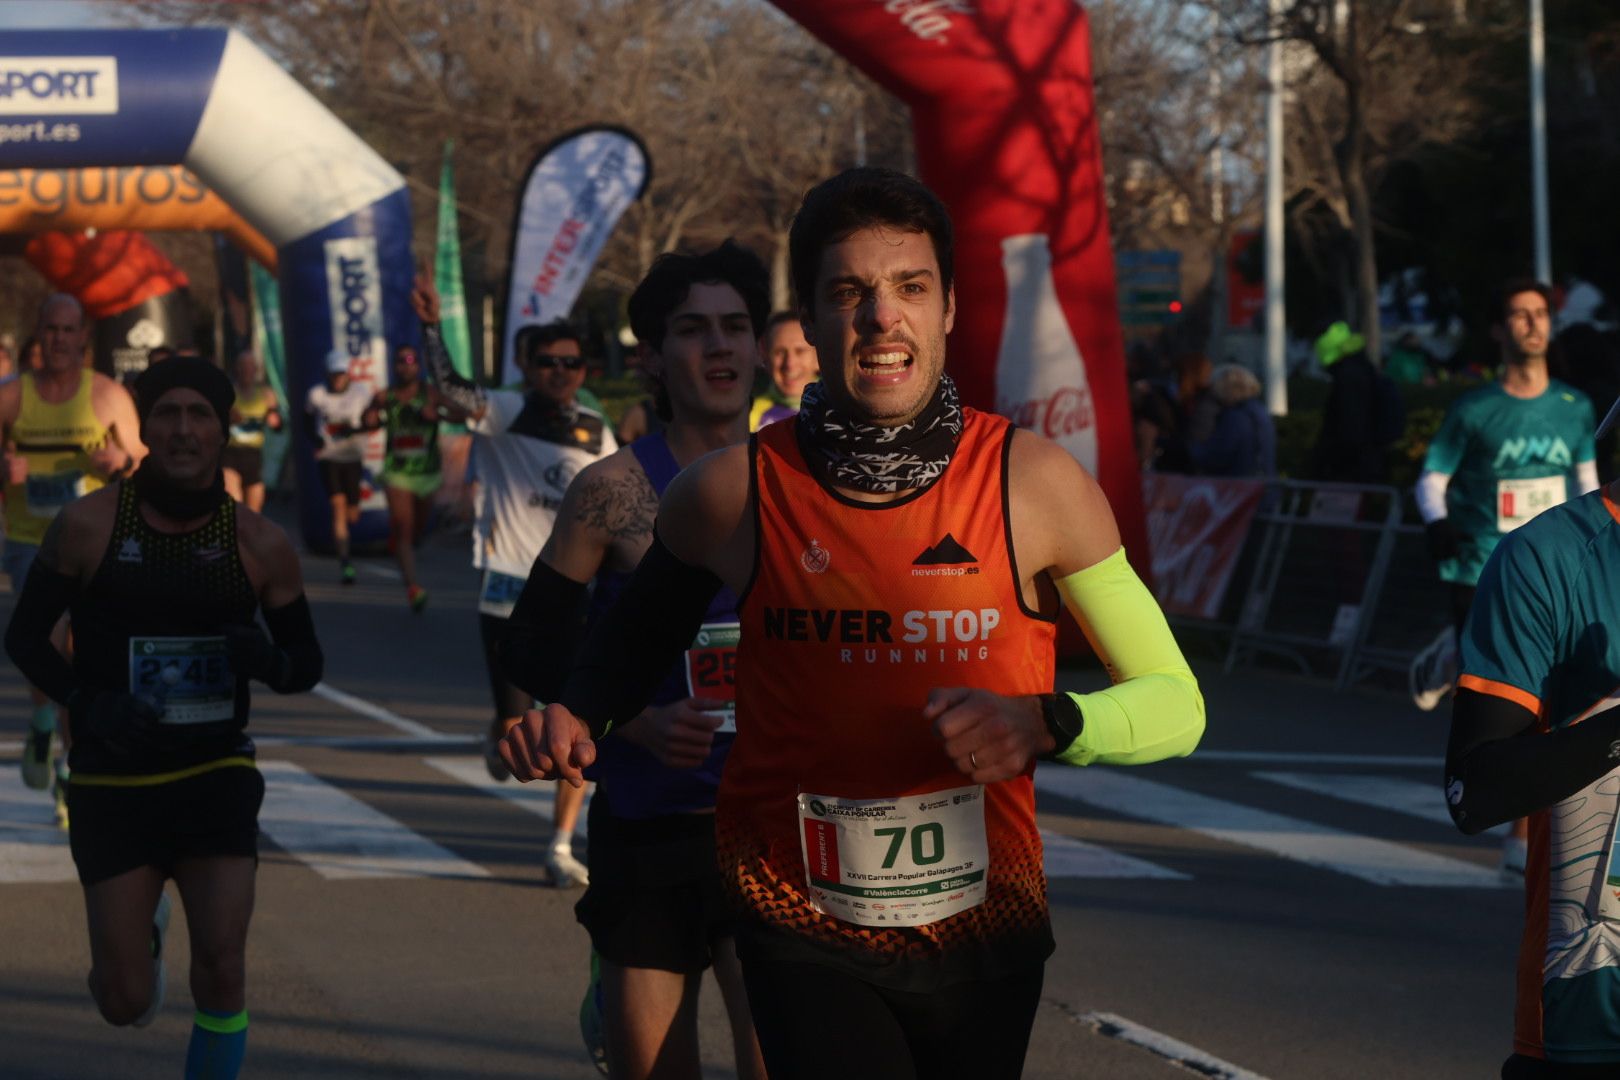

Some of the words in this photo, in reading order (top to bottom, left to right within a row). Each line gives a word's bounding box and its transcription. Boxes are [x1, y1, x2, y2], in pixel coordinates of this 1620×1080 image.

[911, 566, 980, 578] neverstop.es
[764, 607, 893, 644] NEVER
[902, 607, 1000, 643] STOP
[841, 646, 988, 664] RUNNING
[818, 831, 829, 876] PREFERENT
[874, 822, 945, 869] 70
[847, 871, 867, 881] XXVII
[868, 873, 897, 881] Carrera
[898, 871, 926, 882] Popular
